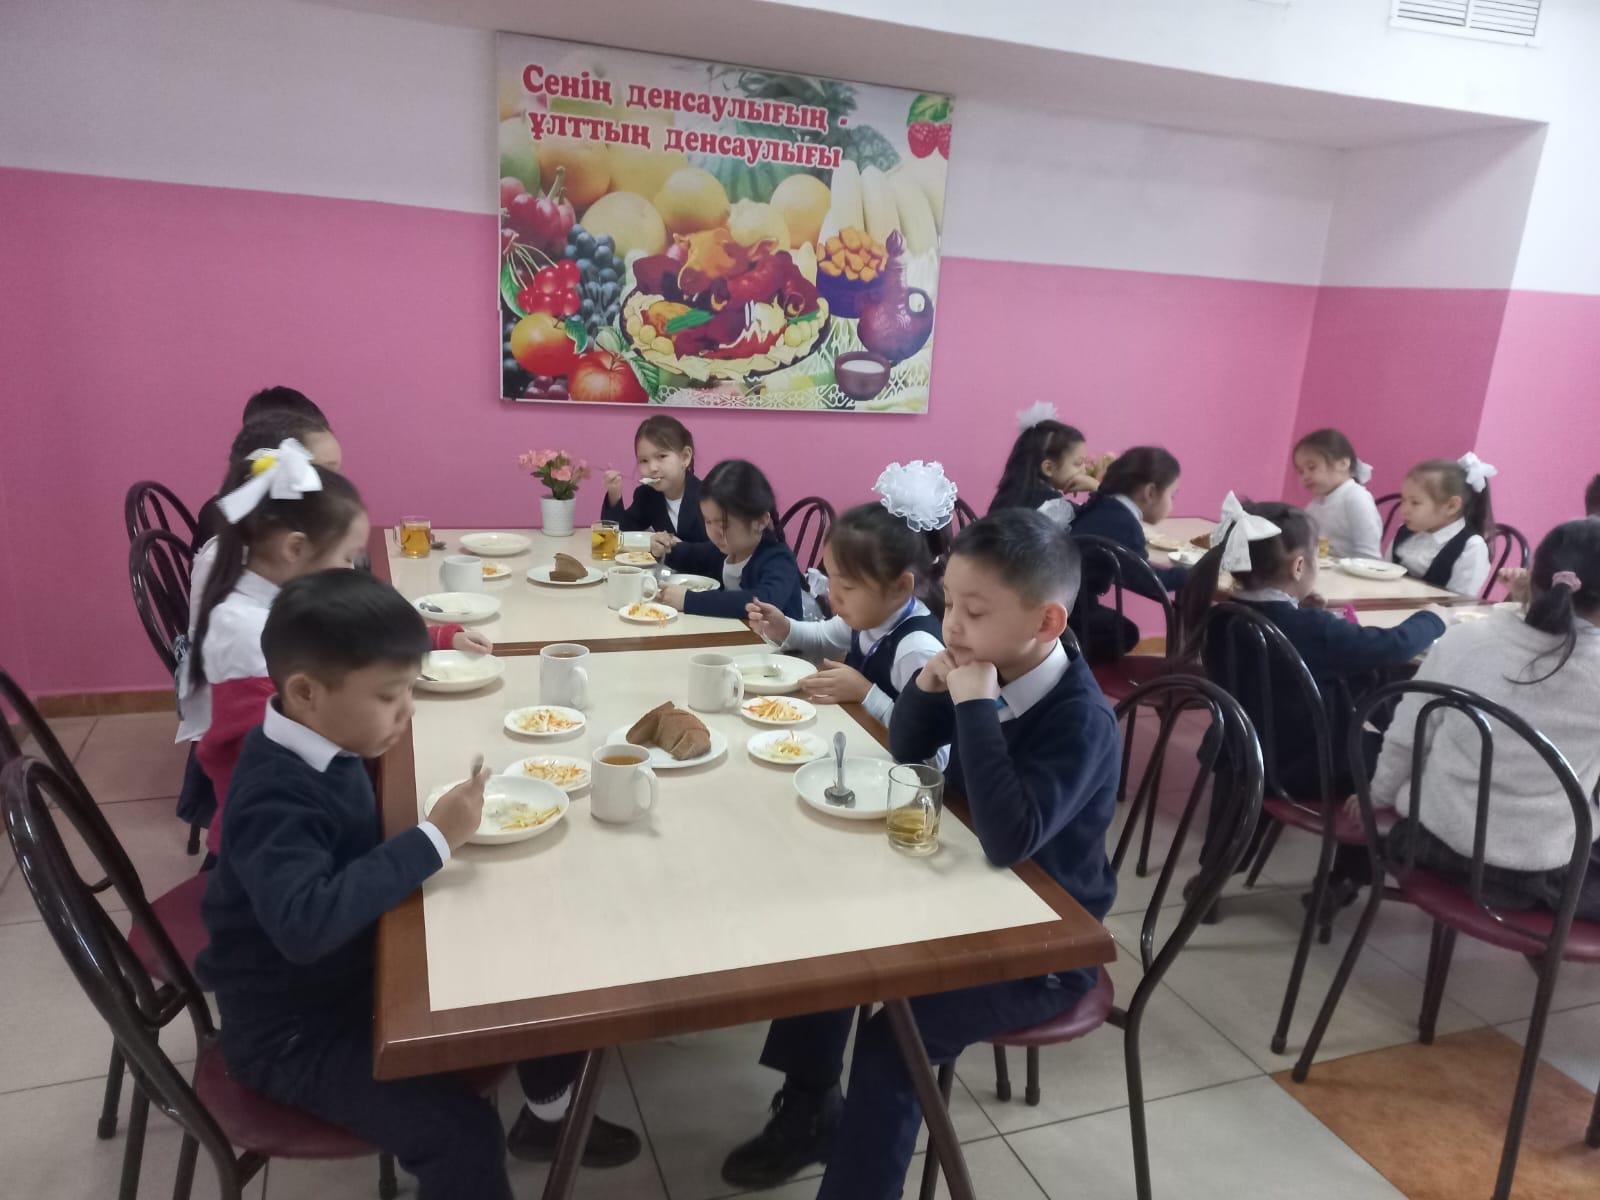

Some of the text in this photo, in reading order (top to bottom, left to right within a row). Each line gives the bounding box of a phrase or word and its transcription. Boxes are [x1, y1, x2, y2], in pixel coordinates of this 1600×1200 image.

[522, 64, 612, 105] Сенің
[627, 84, 828, 131] денсаулығың
[528, 112, 842, 168] ұлттың денсаулығы
